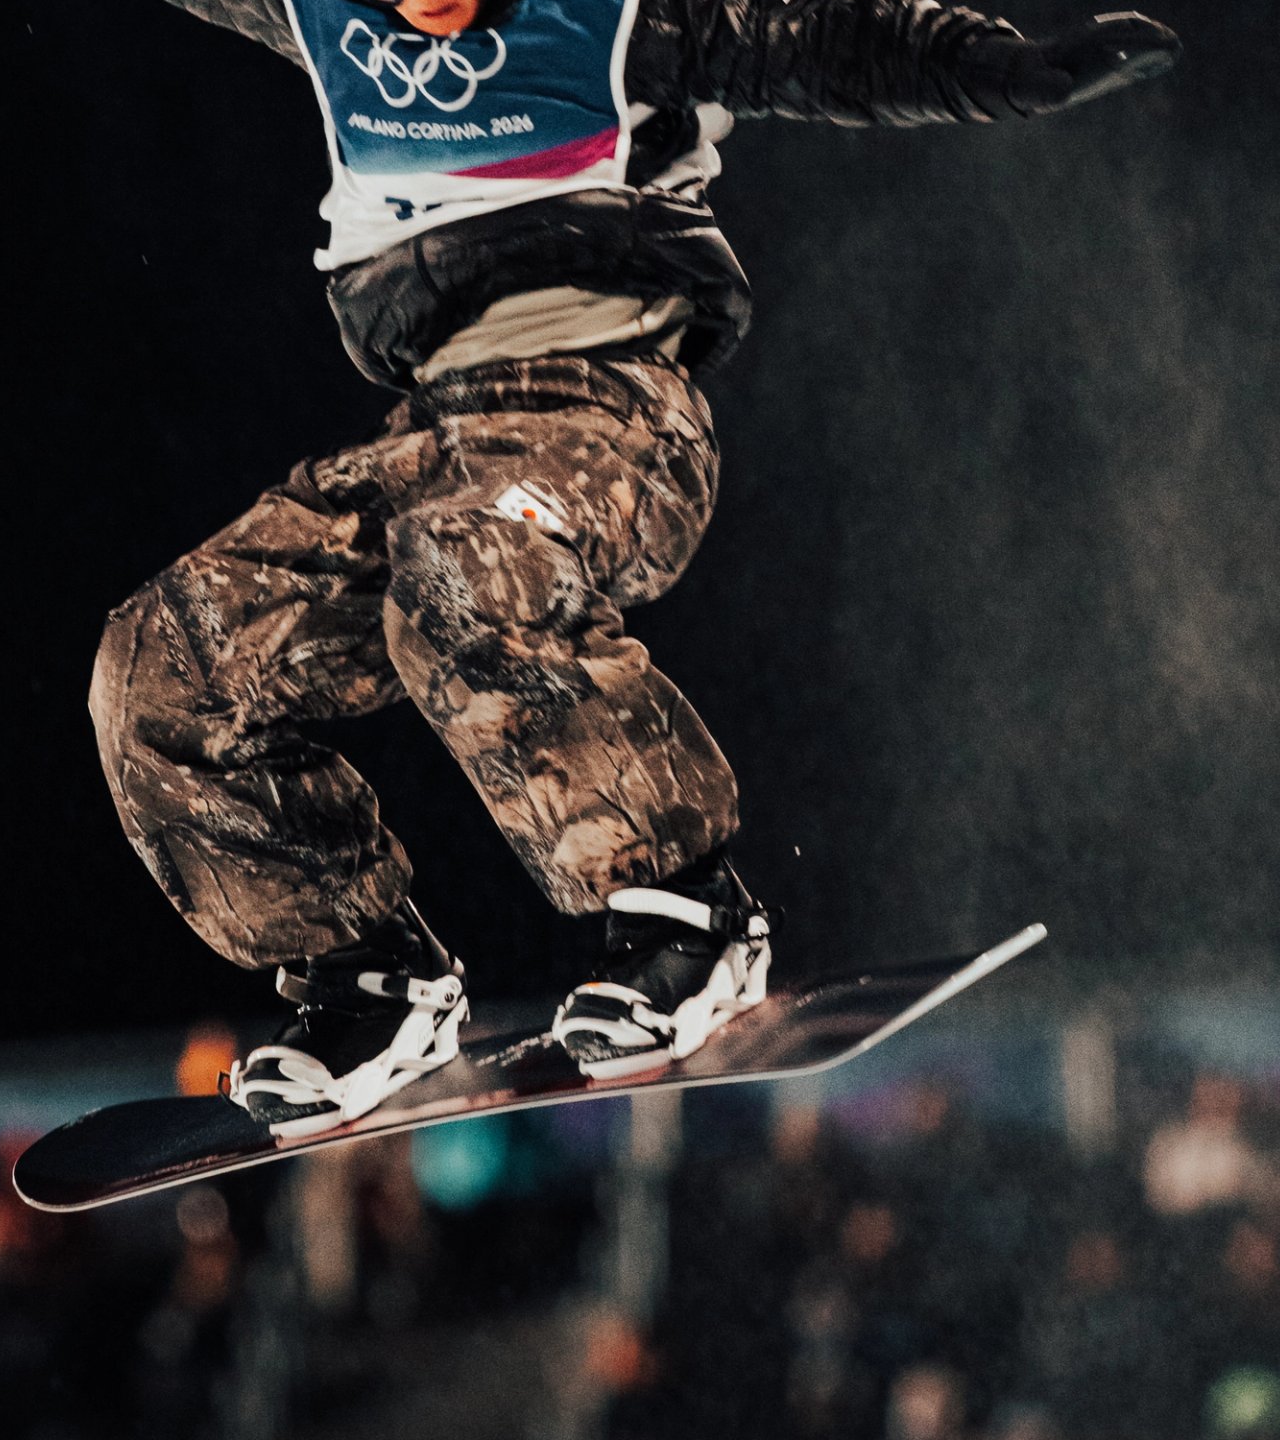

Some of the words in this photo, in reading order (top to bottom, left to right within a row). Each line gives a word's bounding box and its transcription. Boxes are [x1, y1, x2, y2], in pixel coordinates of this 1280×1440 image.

[348, 112, 406, 140] MILANO
[407, 122, 489, 141] CORTINA
[490, 113, 535, 137] 2026
